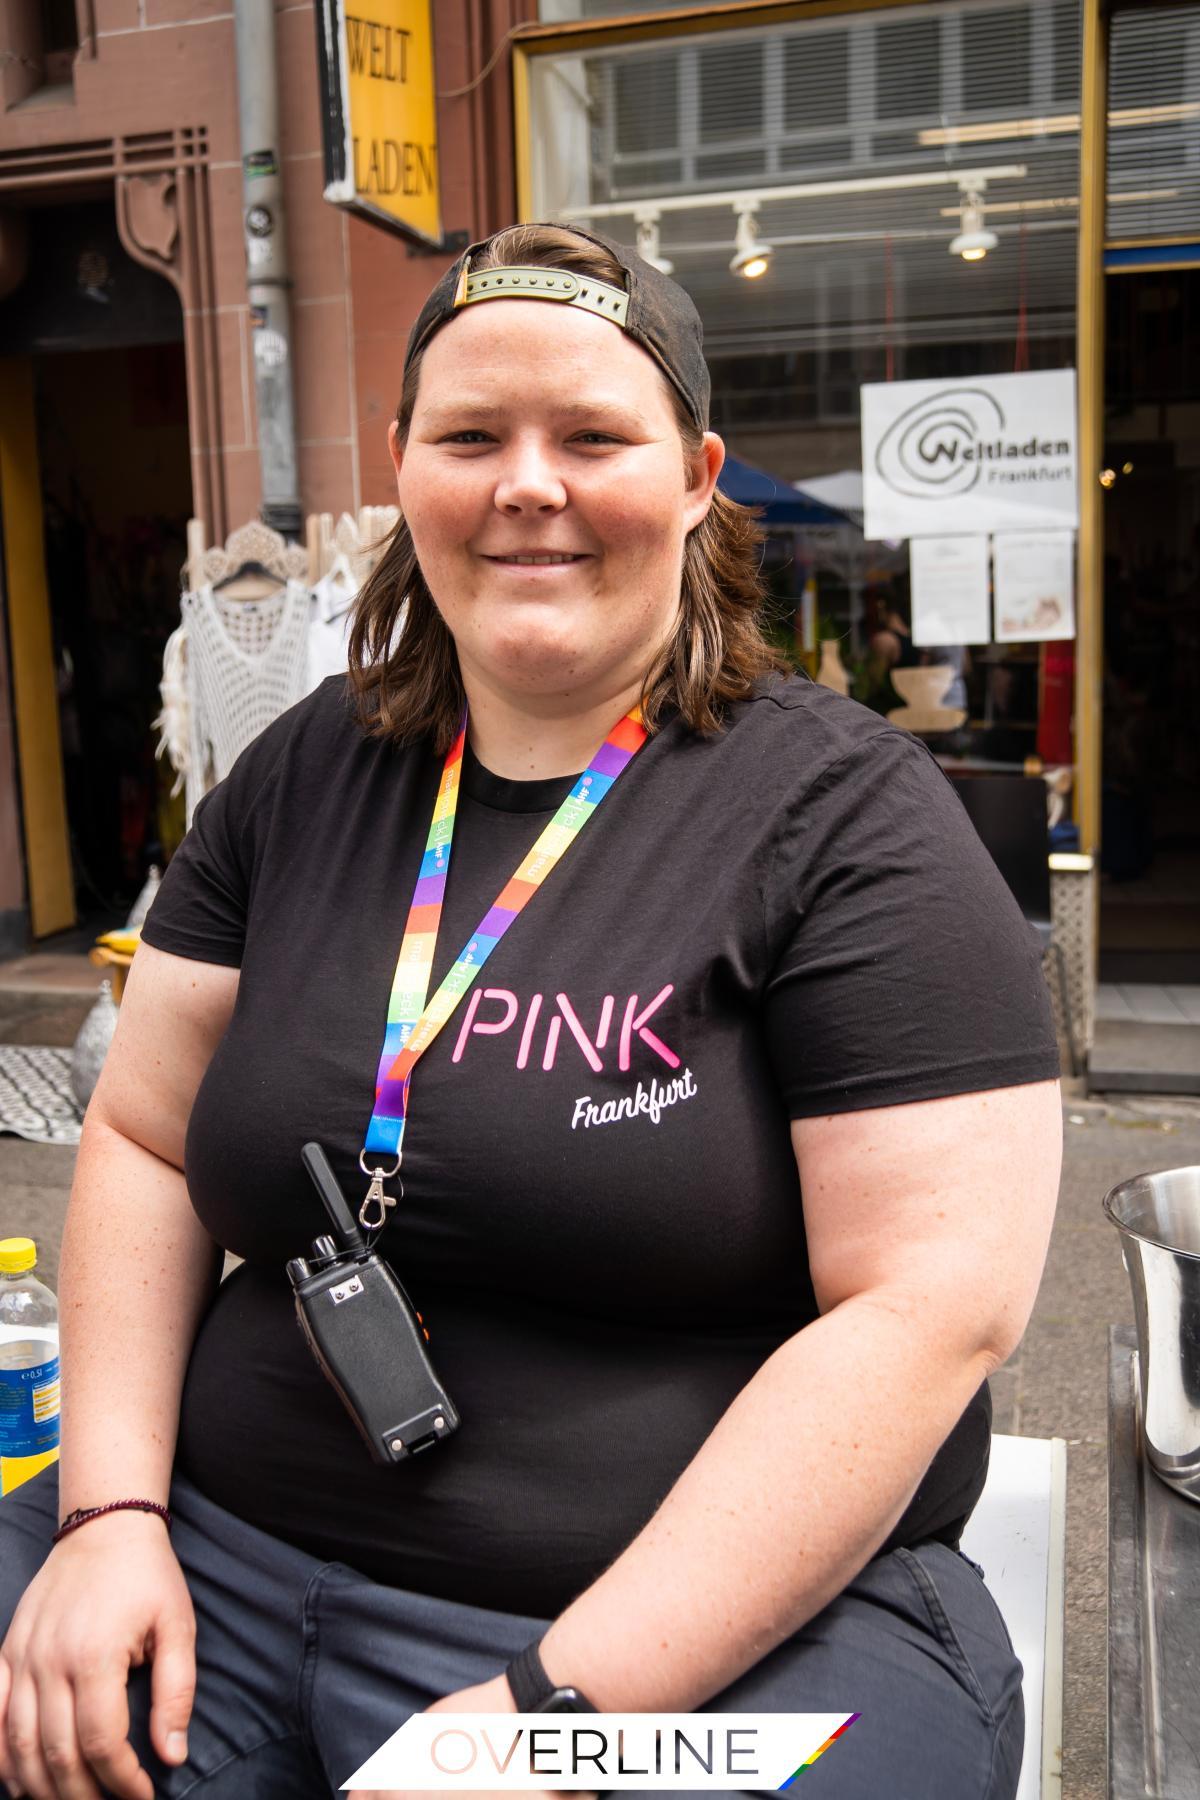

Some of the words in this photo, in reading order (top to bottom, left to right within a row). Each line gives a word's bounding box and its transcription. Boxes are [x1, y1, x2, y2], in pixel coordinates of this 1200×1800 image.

[345, 15, 411, 84] WELT
[352, 136, 438, 196] LADEN
[918, 430, 1070, 463] Weltladen
[988, 467, 1073, 484] Frankfurt
[435, 769, 456, 838] maineck
[527, 811, 579, 878] maineck
[575, 787, 590, 806] AHF
[451, 983, 682, 1073] PINK
[571, 1068, 698, 1130] Frankfurt
